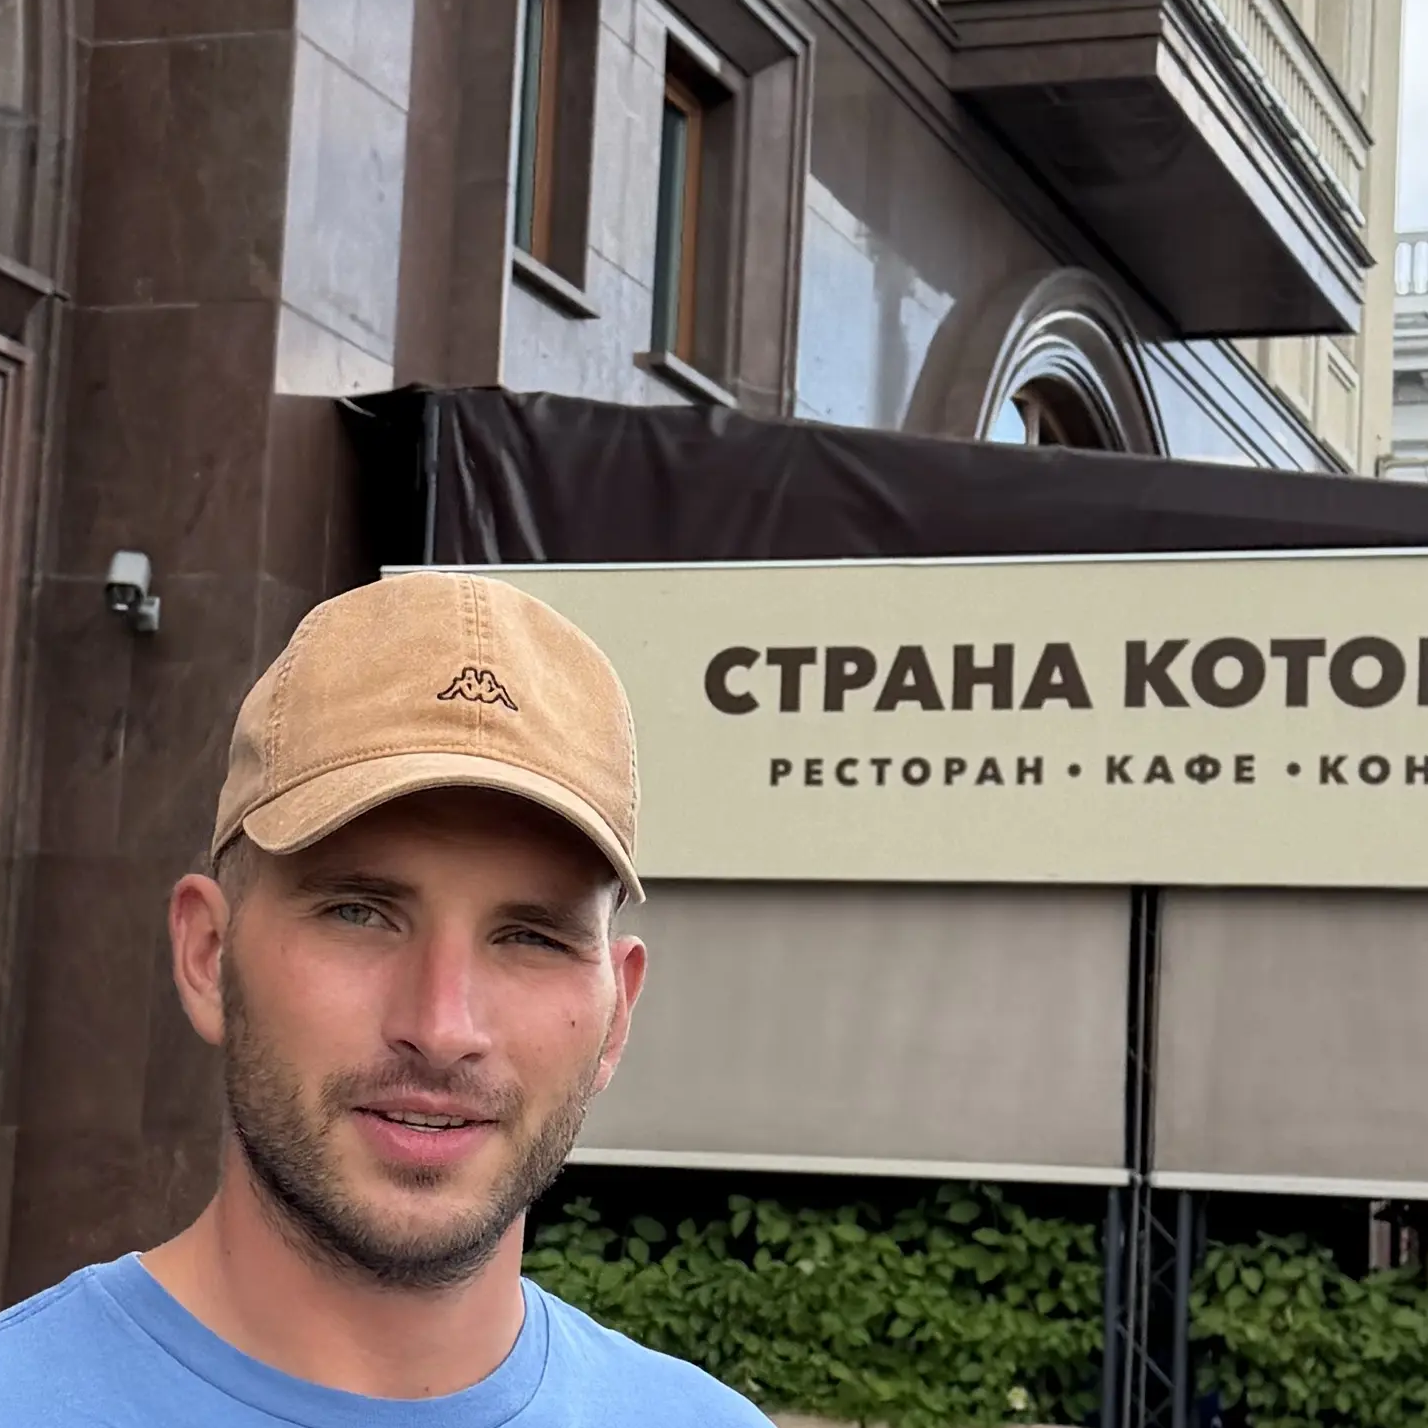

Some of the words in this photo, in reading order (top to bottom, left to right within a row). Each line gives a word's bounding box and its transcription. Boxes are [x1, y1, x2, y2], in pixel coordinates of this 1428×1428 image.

[703, 641, 1094, 716] СТРАНА
[768, 756, 1044, 788] РЕСТОРАН
[1105, 754, 1257, 786] КАФЕ
